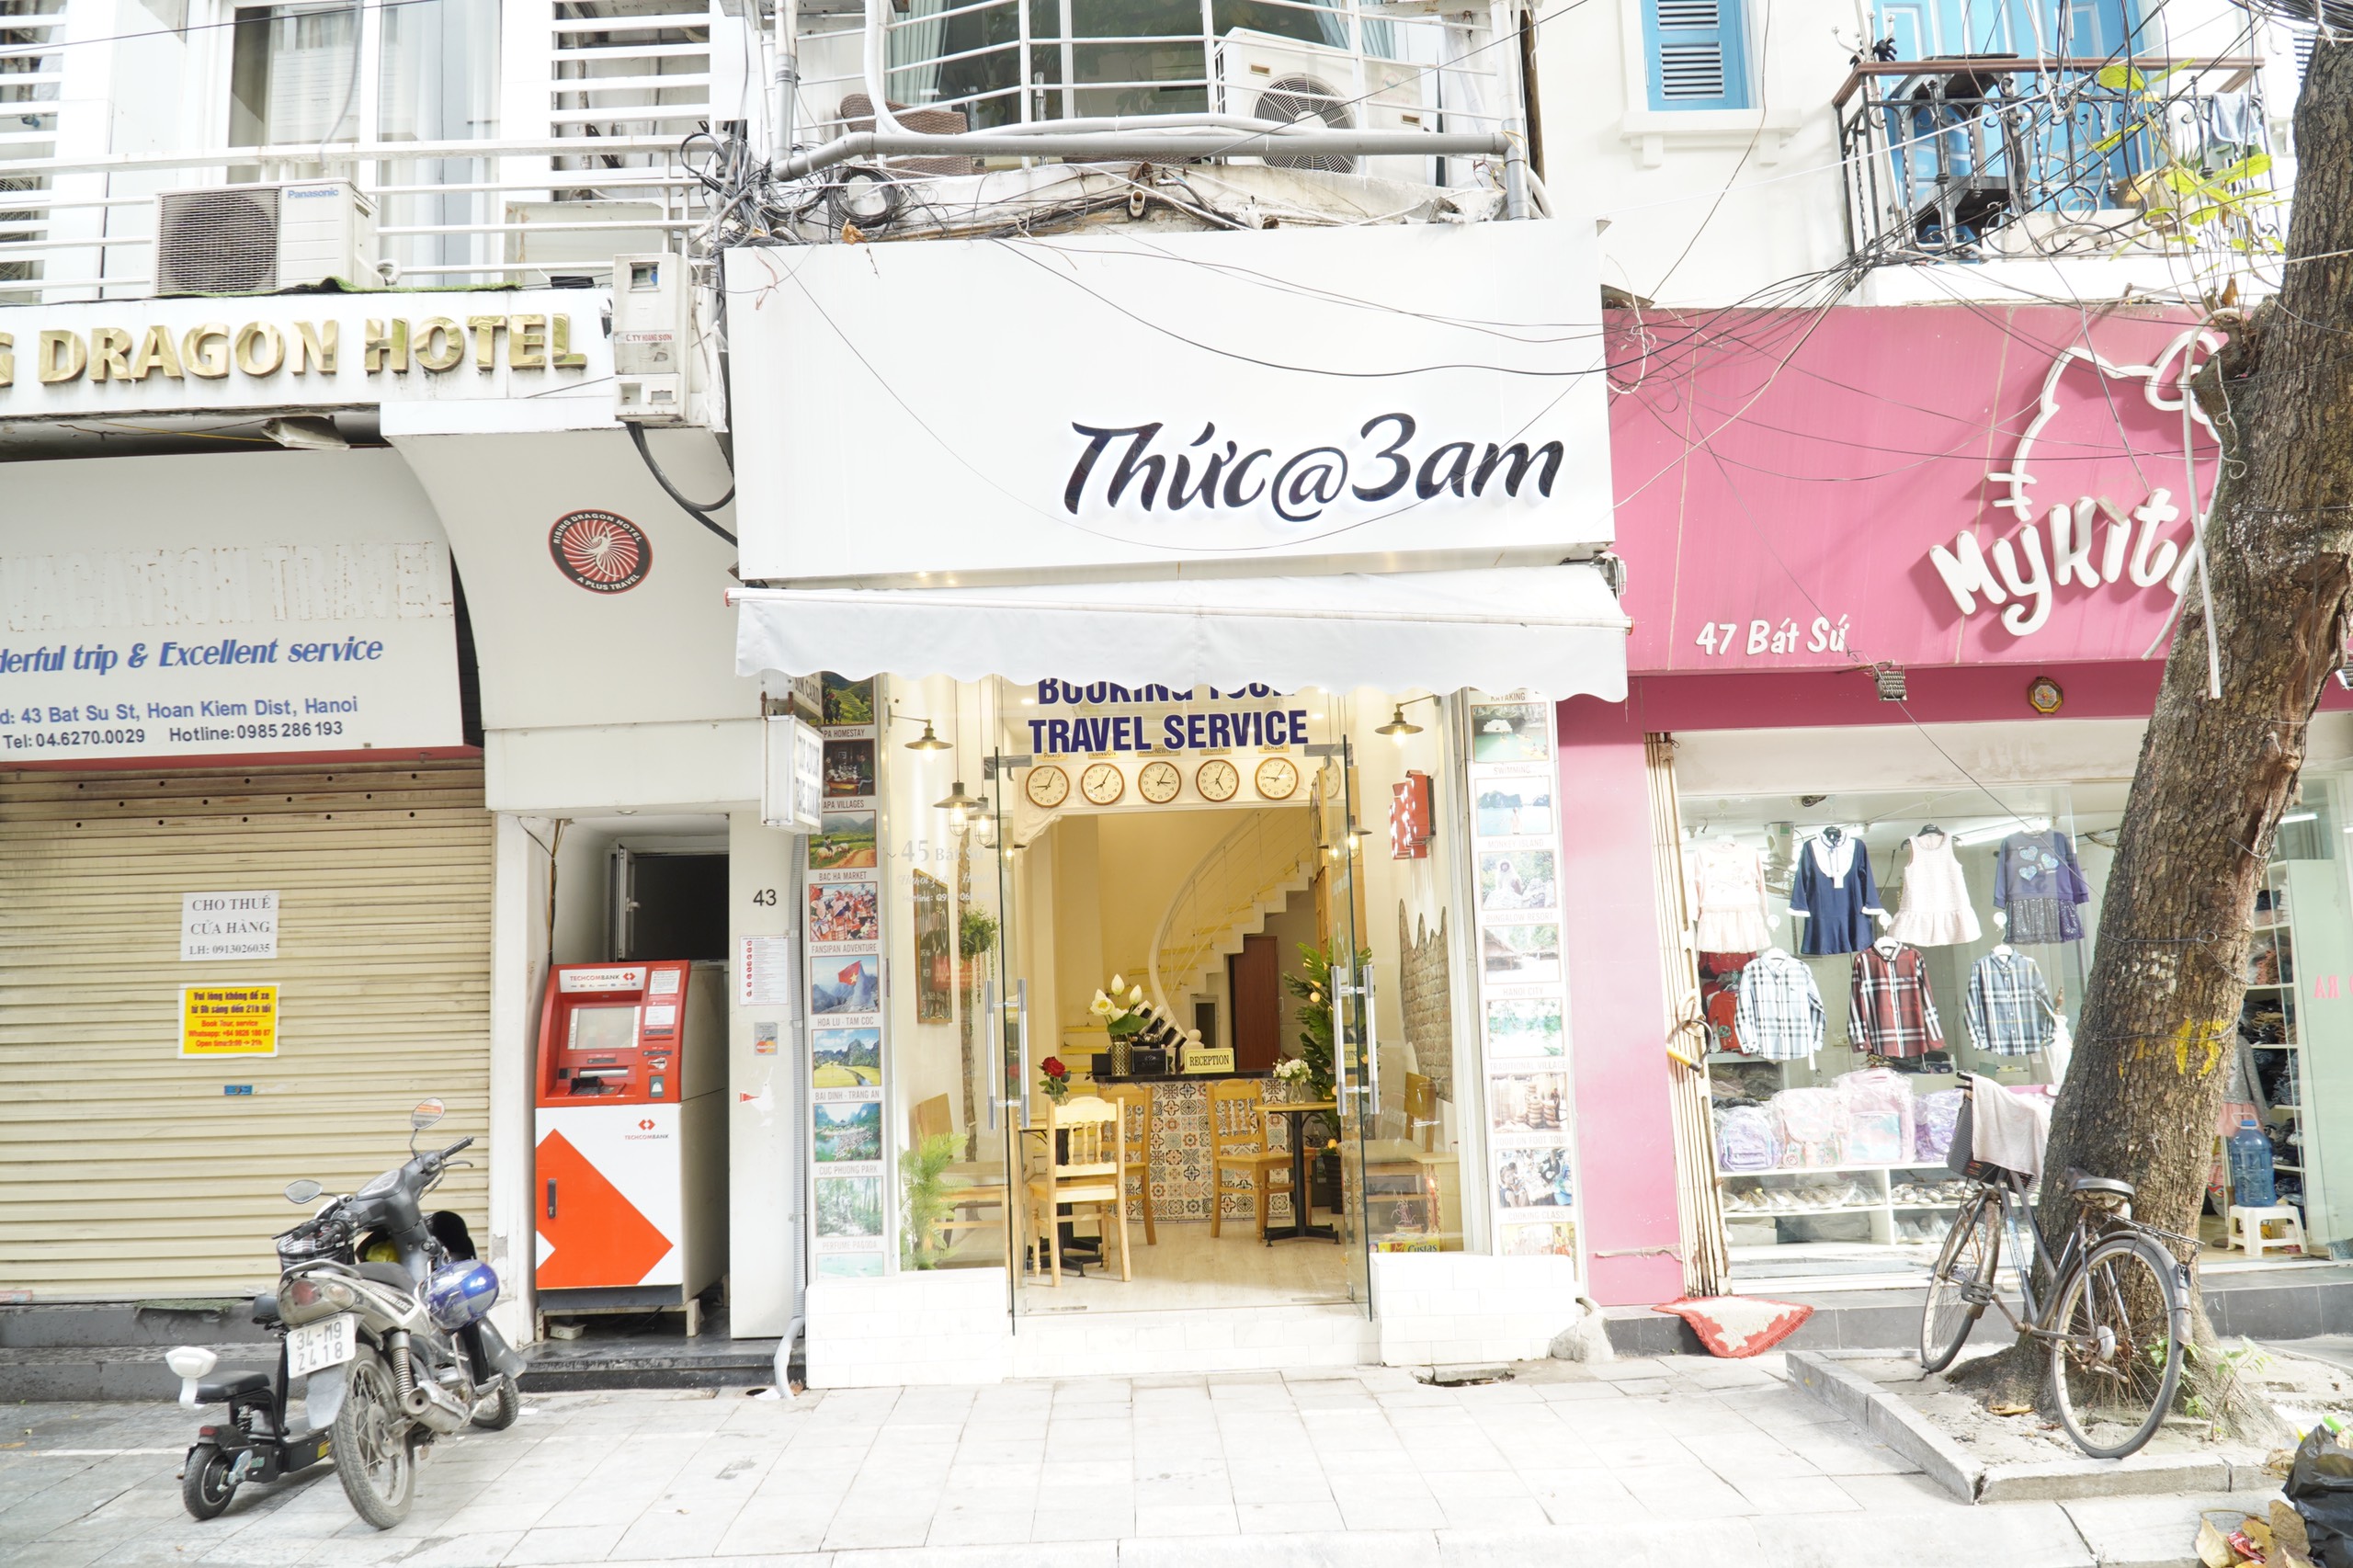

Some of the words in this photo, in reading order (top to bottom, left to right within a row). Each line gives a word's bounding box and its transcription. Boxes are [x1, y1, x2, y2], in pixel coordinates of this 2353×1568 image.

[287, 187, 339, 199] Panasonic
[38, 320, 339, 386] DRAGON
[366, 312, 588, 375] HOTEL
[1063, 411, 1564, 522] Thức@3am
[553, 519, 572, 544] RISING
[571, 513, 615, 522] DRAGON
[616, 518, 642, 542] HOTEL
[585, 580, 608, 591] PLUS
[609, 574, 641, 590] TRAVEL
[1695, 621, 1738, 655] 47
[1746, 617, 1800, 655] Bát
[1807, 613, 1850, 653] Sứ
[74, 643, 118, 676] trip
[128, 643, 149, 668] &
[159, 637, 278, 667] Excellent
[288, 635, 383, 663] service
[1038, 677, 1193, 705] BOOK
[21, 708, 42, 724] 43
[49, 706, 79, 723] Bat
[86, 705, 108, 722] Su
[116, 703, 140, 722] St,
[147, 701, 194, 719] Hoan
[201, 699, 247, 717] Kiem
[255, 699, 298, 717] Dist,
[304, 696, 358, 714] Hanoi
[6, 733, 33, 749] Tel:
[36, 729, 145, 747] 04.6270.0029
[169, 725, 235, 743] Hotline:
[236, 723, 277, 739] 0985
[281, 722, 312, 737] 286
[315, 721, 344, 735] 193
[834, 729, 865, 737] HOMESTAY
[1028, 716, 1152, 754] TRAVEL
[1164, 710, 1309, 750] SERVICE
[1494, 765, 1530, 775] SWIMMING
[823, 801, 835, 809] APA
[837, 800, 864, 809] VILLAGES
[1487, 839, 1516, 849] MONKEY
[1518, 838, 1544, 848] ISLAND
[901, 839, 930, 862] 45
[819, 872, 831, 882] BAC
[833, 872, 841, 881] HA
[843, 871, 867, 881] MARKET
[753, 889, 778, 907] 43
[192, 899, 225, 911] CHO
[1486, 914, 1525, 923] BUNGALOW
[1527, 912, 1553, 921] RESORT
[190, 919, 222, 935] CỬA
[226, 918, 270, 934] HÀNG
[189, 945, 210, 955] LH:
[212, 943, 270, 954] 0913026035
[811, 944, 840, 954] FANSIPAN
[841, 943, 877, 953] ADVENTURE
[570, 974, 620, 983] TECHCOMBANK
[1503, 987, 1525, 996] HANOI
[1528, 986, 1544, 995] CITY
[817, 1017, 828, 1027] HOA
[830, 1017, 840, 1027] LU
[845, 1016, 858, 1026] TAM
[859, 1016, 874, 1026] COC
[1189, 1054, 1230, 1067] RECEPTION
[1490, 1062, 1534, 1072] TRADITIONAL
[1537, 1060, 1566, 1070] VILLAGE
[815, 1091, 827, 1101] BAI
[828, 1091, 844, 1100] DINH
[847, 1090, 869, 1100] TRANG
[870, 1090, 880, 1099] AN
[1495, 1137, 1514, 1146] FOOD
[1517, 1137, 1527, 1145] ON
[1529, 1136, 1547, 1145] FOOT
[819, 1165, 832, 1175] CUC
[834, 1165, 858, 1175] PHUONG
[859, 1165, 878, 1174] PARK
[1508, 1211, 1540, 1221] COOKING
[1541, 1210, 1565, 1220] CLASS
[822, 1241, 851, 1251] PERFUME
[853, 1241, 877, 1250] PAGODA
[296, 1322, 344, 1351] 34-M9
[298, 1342, 344, 1372] 2418
